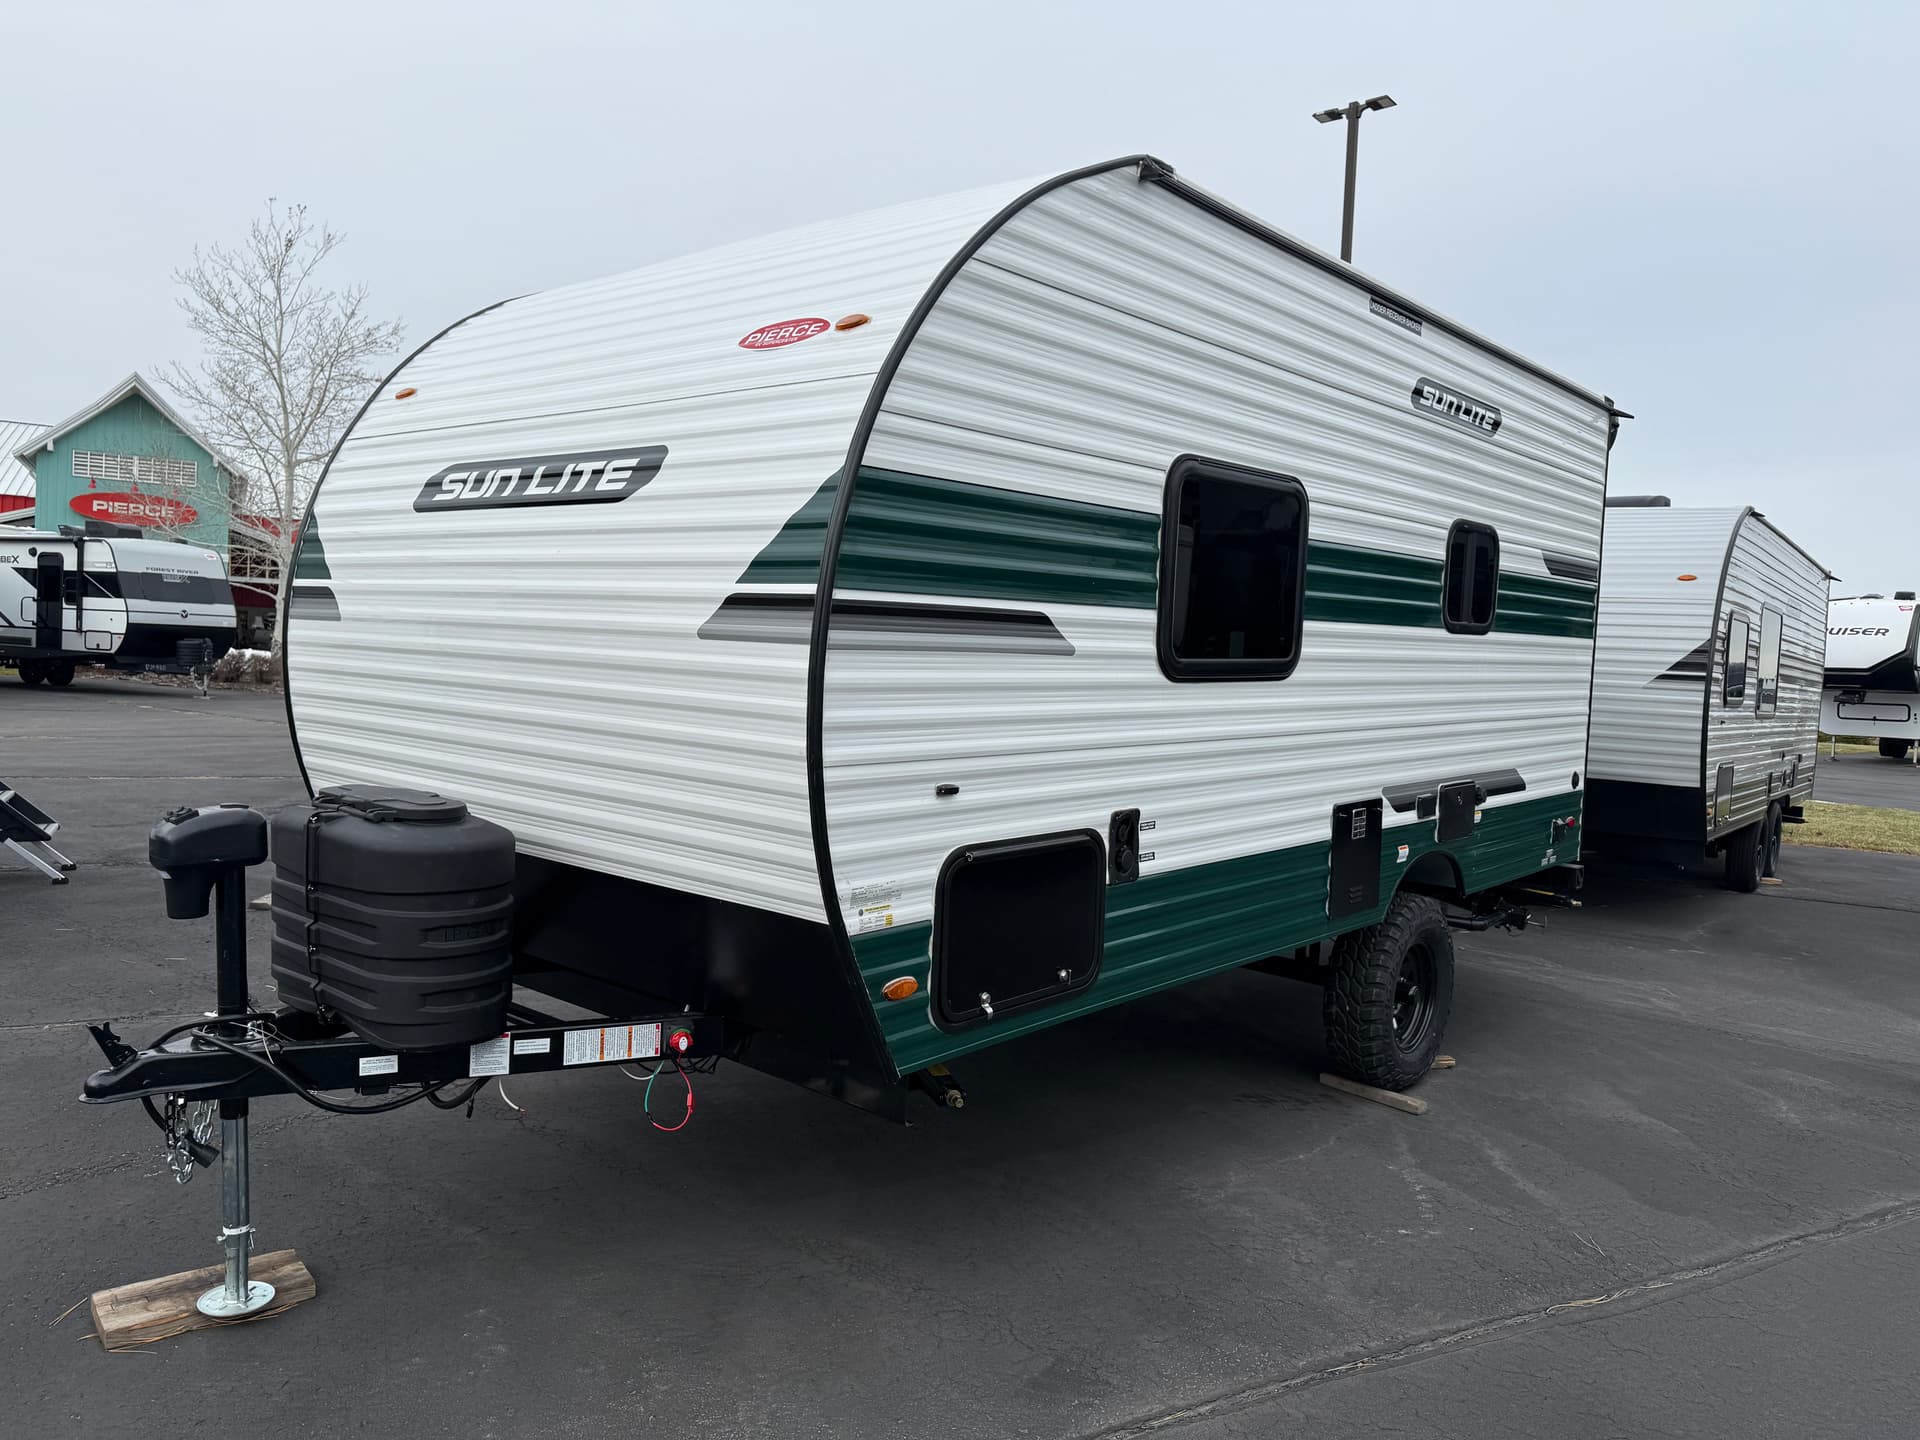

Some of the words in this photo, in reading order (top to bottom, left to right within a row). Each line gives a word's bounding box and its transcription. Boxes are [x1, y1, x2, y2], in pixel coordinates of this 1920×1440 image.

[744, 322, 824, 345] PIERCE
[1419, 385, 1457, 416] SUN
[1458, 400, 1496, 431] LITE
[431, 467, 522, 501] SUN
[522, 457, 641, 496] LITE
[92, 499, 175, 518] PIERCE
[145, 566, 175, 574] FOREST
[1826, 627, 1890, 637] UISER
